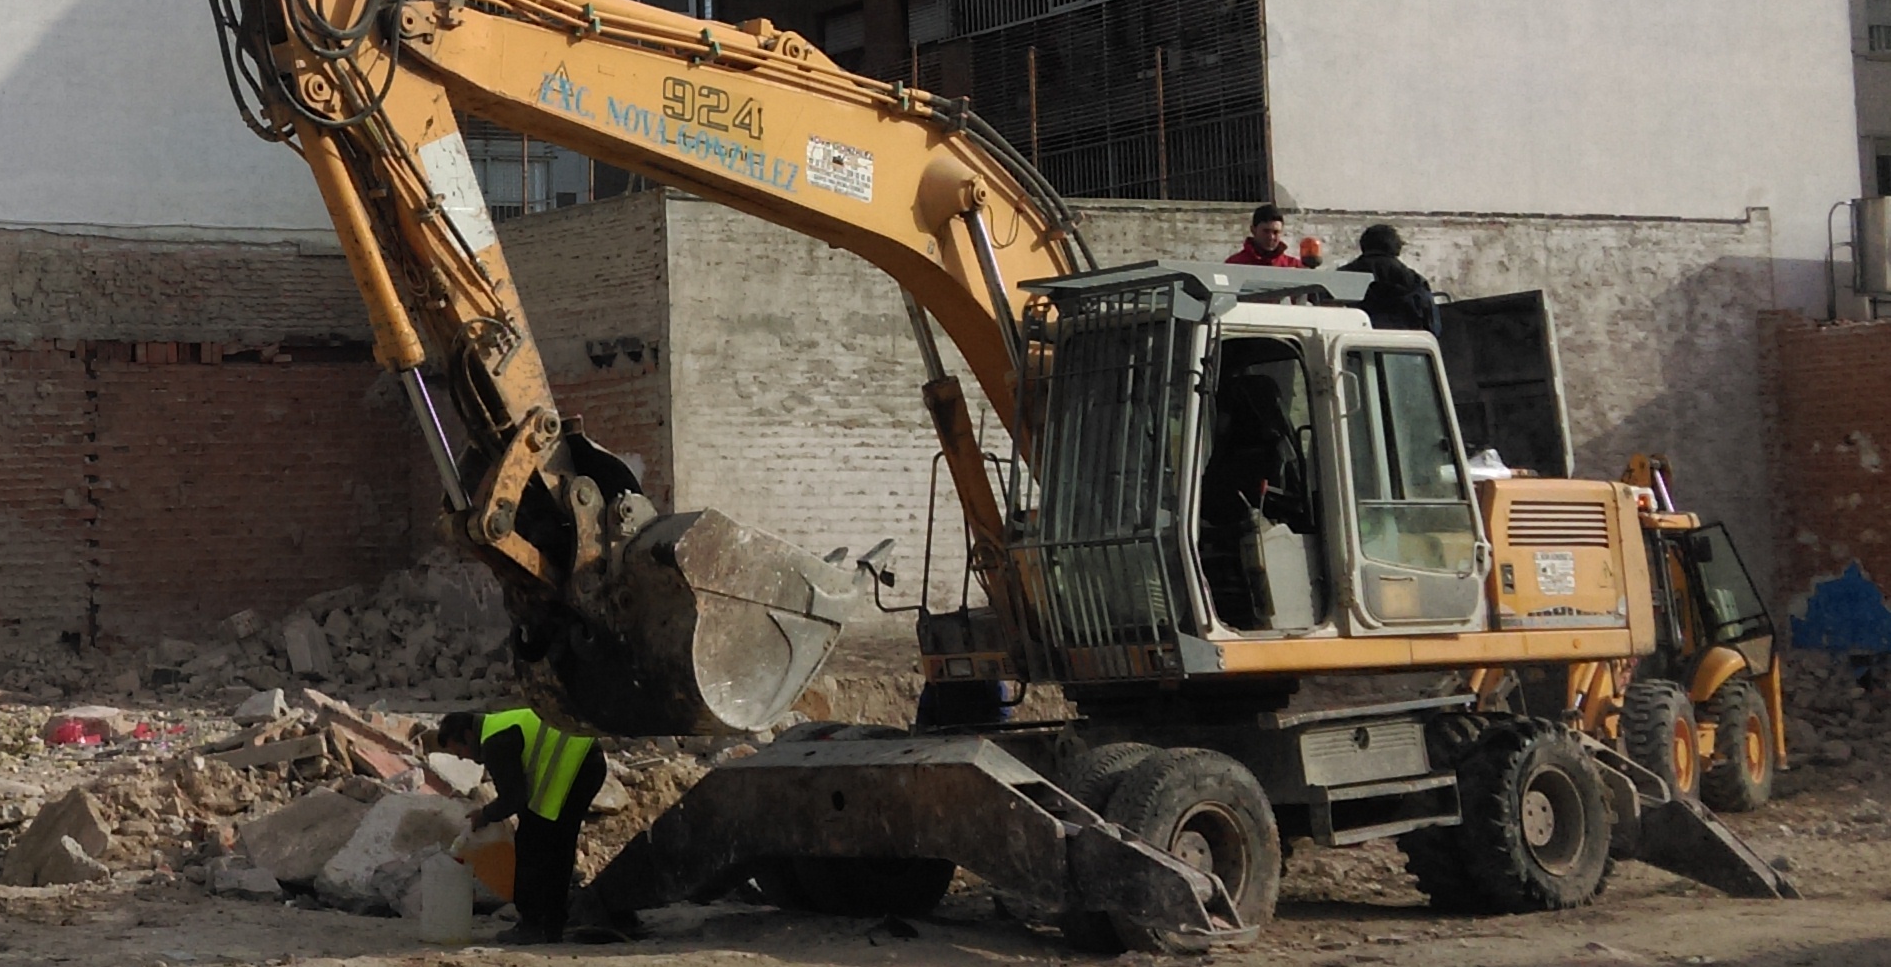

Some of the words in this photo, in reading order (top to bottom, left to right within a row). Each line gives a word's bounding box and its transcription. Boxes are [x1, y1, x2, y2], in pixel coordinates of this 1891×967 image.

[606, 95, 668, 146] NOVA
[676, 124, 799, 193] GONZALEZ
[663, 76, 764, 140] 924
